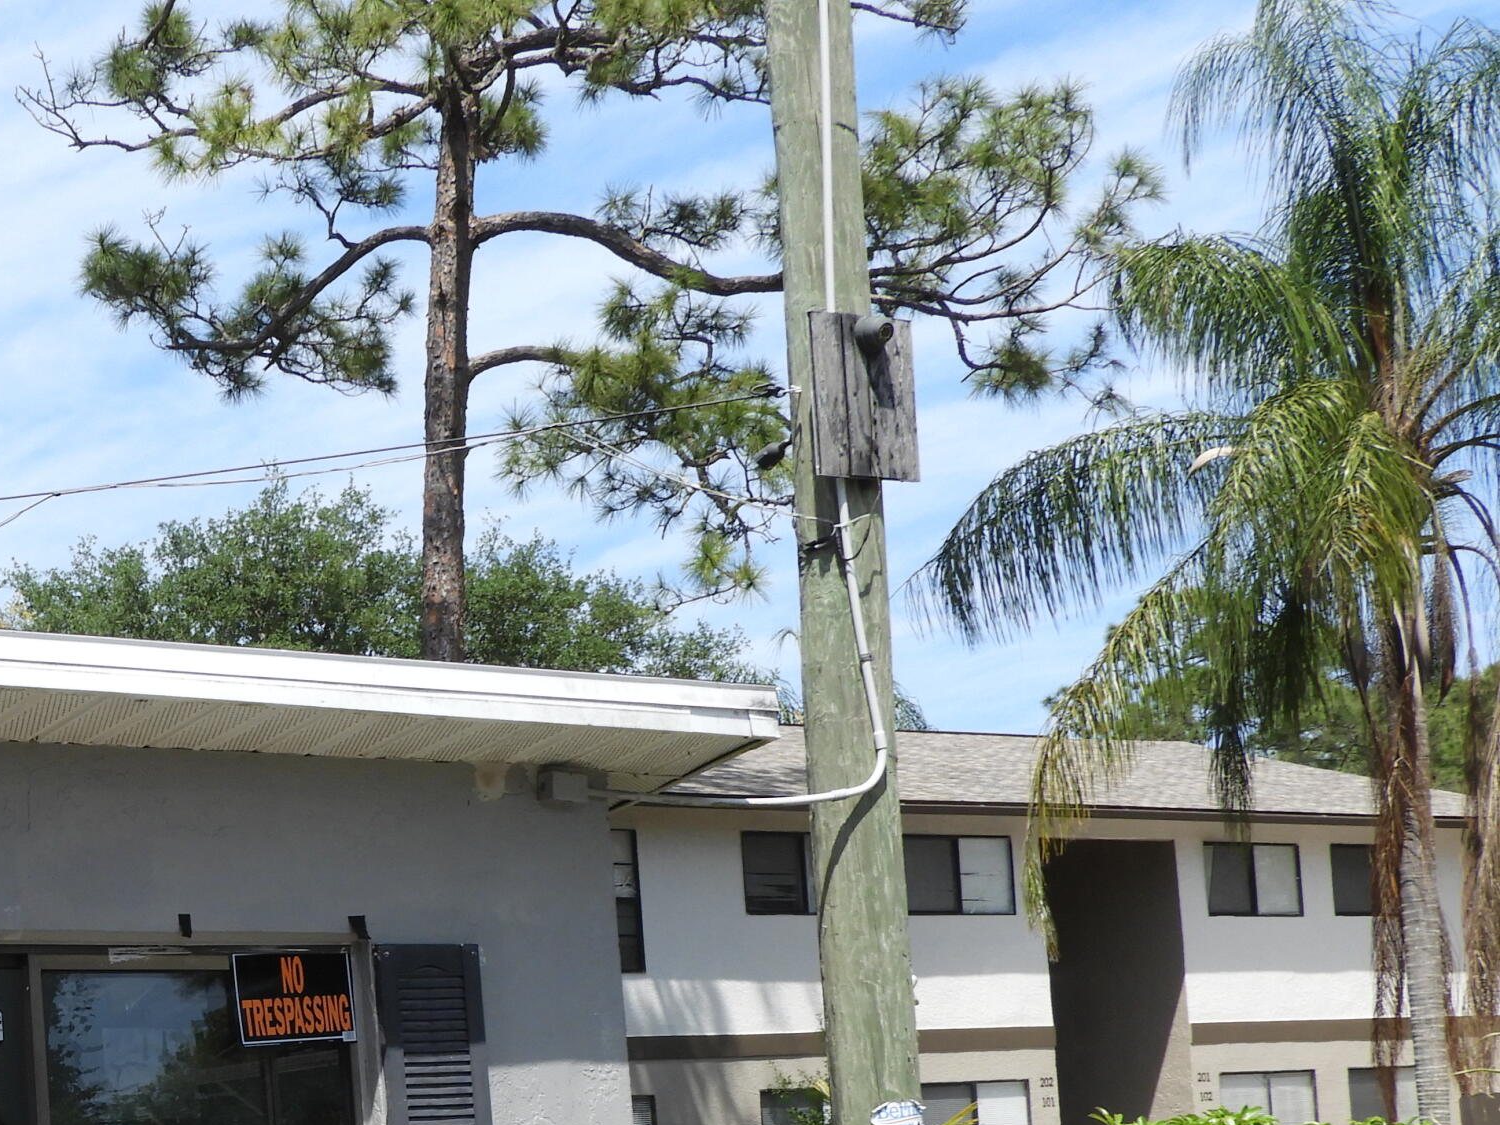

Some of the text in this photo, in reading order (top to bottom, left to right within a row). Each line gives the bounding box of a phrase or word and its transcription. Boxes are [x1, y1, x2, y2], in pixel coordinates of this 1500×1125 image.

[280, 955, 305, 994] NO
[241, 994, 351, 1037] TRESPASSING
[1040, 1077, 1054, 1088] 202
[1197, 1072, 1211, 1083] 201
[1200, 1091, 1213, 1102] 102
[1042, 1097, 1055, 1108] 101
